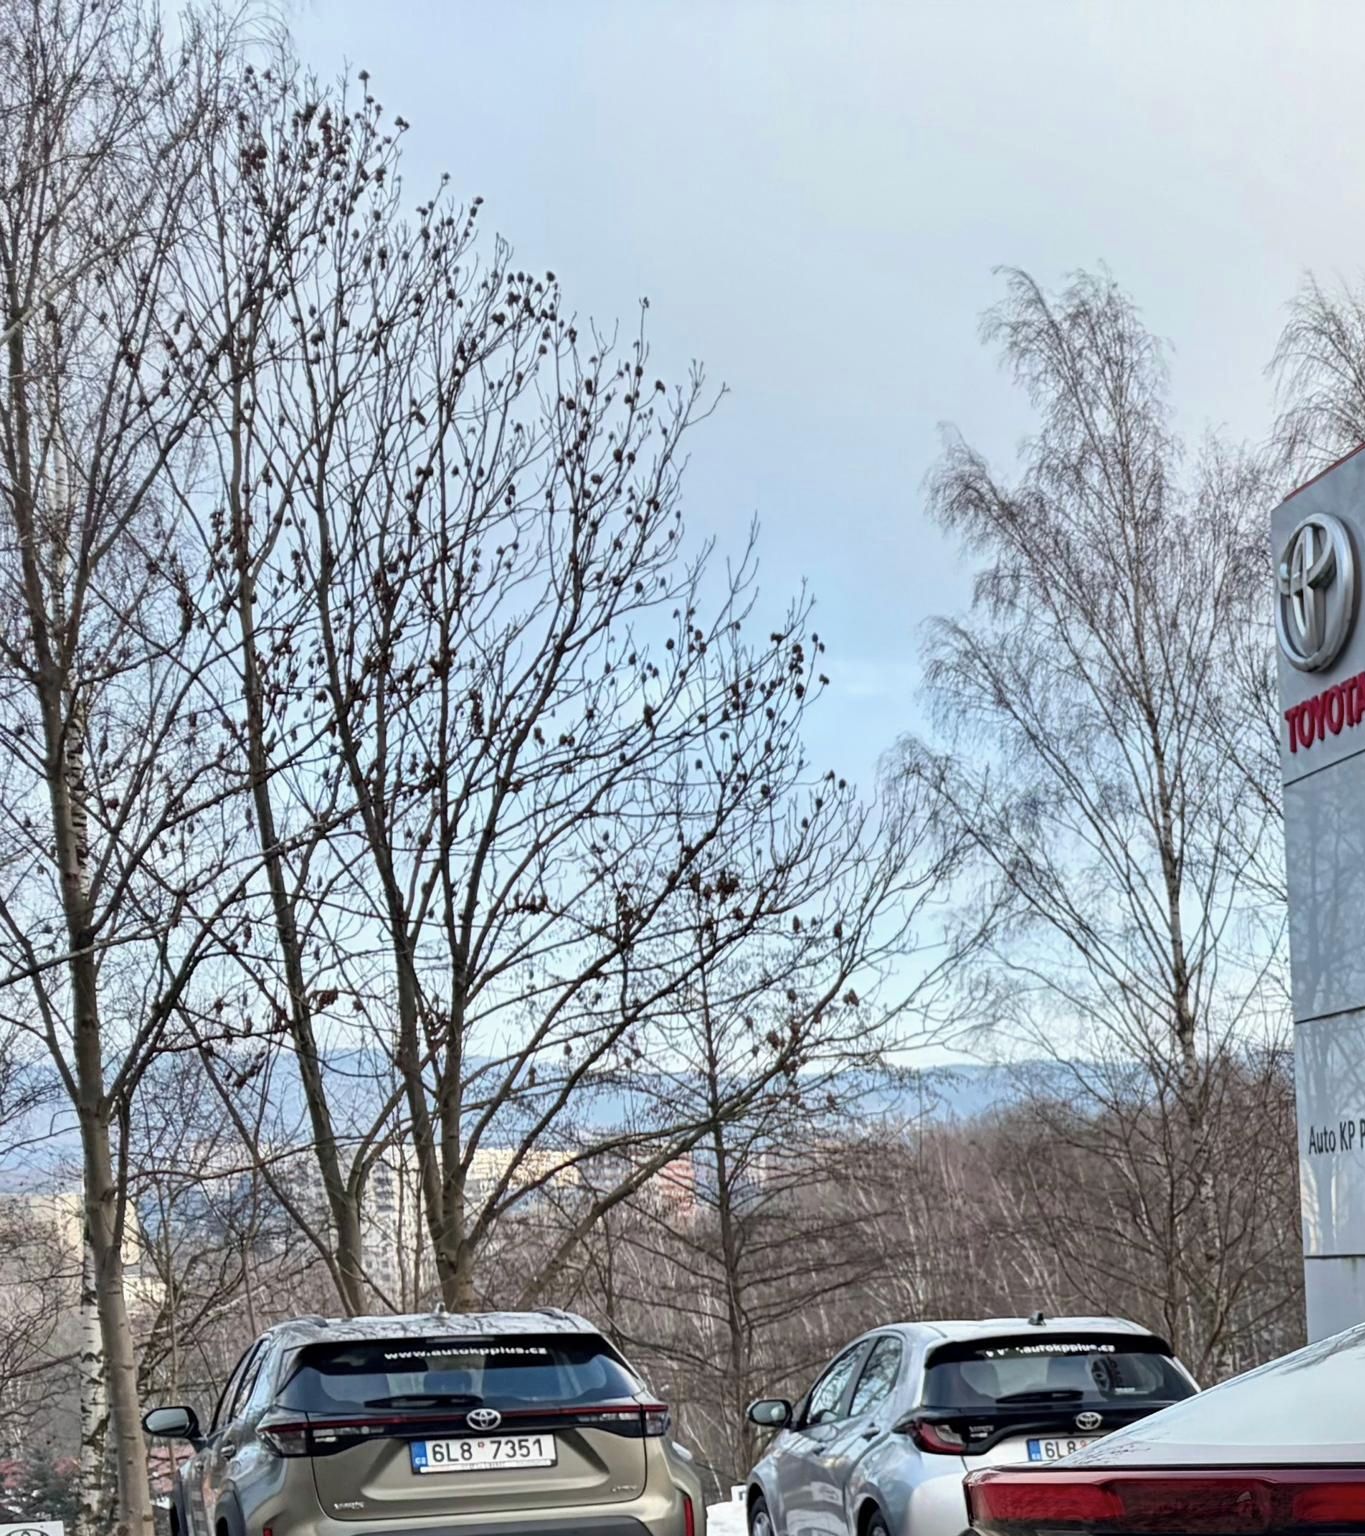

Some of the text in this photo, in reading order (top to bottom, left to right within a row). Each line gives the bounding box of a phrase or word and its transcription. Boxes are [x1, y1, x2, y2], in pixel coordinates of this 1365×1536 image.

[1308, 1125, 1337, 1155] Auto
[1339, 1120, 1356, 1152] KP
[384, 1346, 549, 1361] www.autokpplus.cz
[431, 1438, 545, 1463] 6L8 7351
